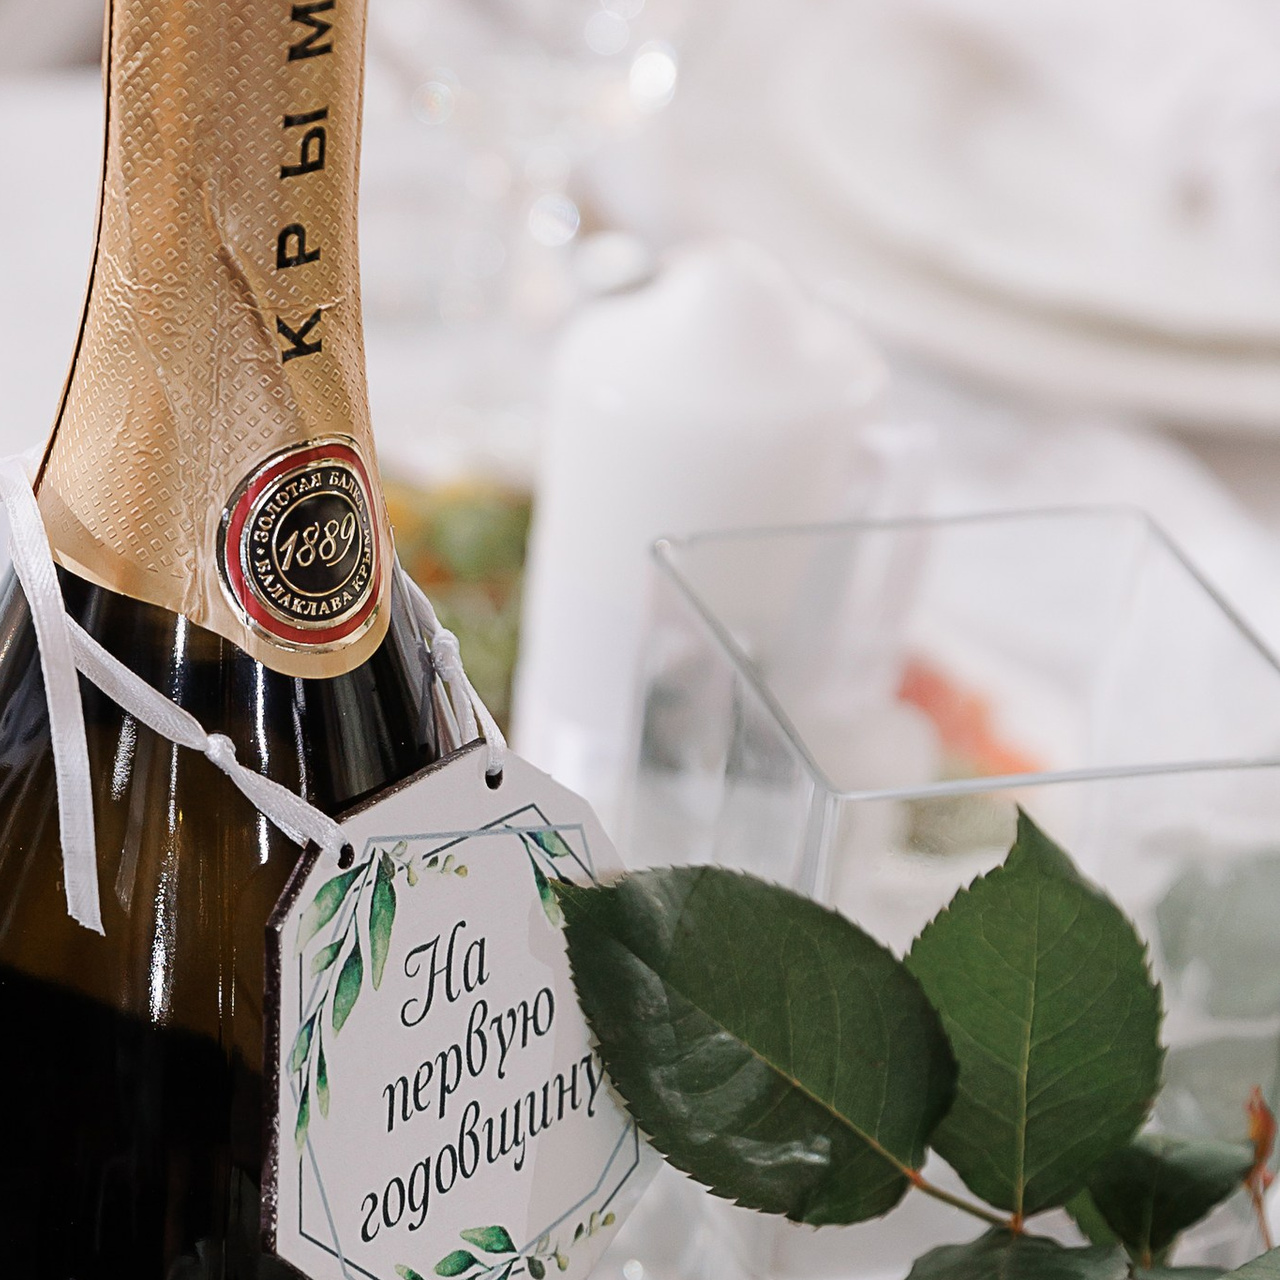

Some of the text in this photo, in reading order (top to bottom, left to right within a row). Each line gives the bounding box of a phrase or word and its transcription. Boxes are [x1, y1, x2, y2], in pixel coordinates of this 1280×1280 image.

[253, 471, 364, 543] ЗОЛОТАЯ БАЛКА
[278, 511, 356, 571] 1889
[255, 530, 373, 616] БАЛАКЛАВА КРЫМ
[400, 920, 490, 1027] На
[382, 986, 555, 1133] первую
[359, 1051, 606, 1243] годовщину
